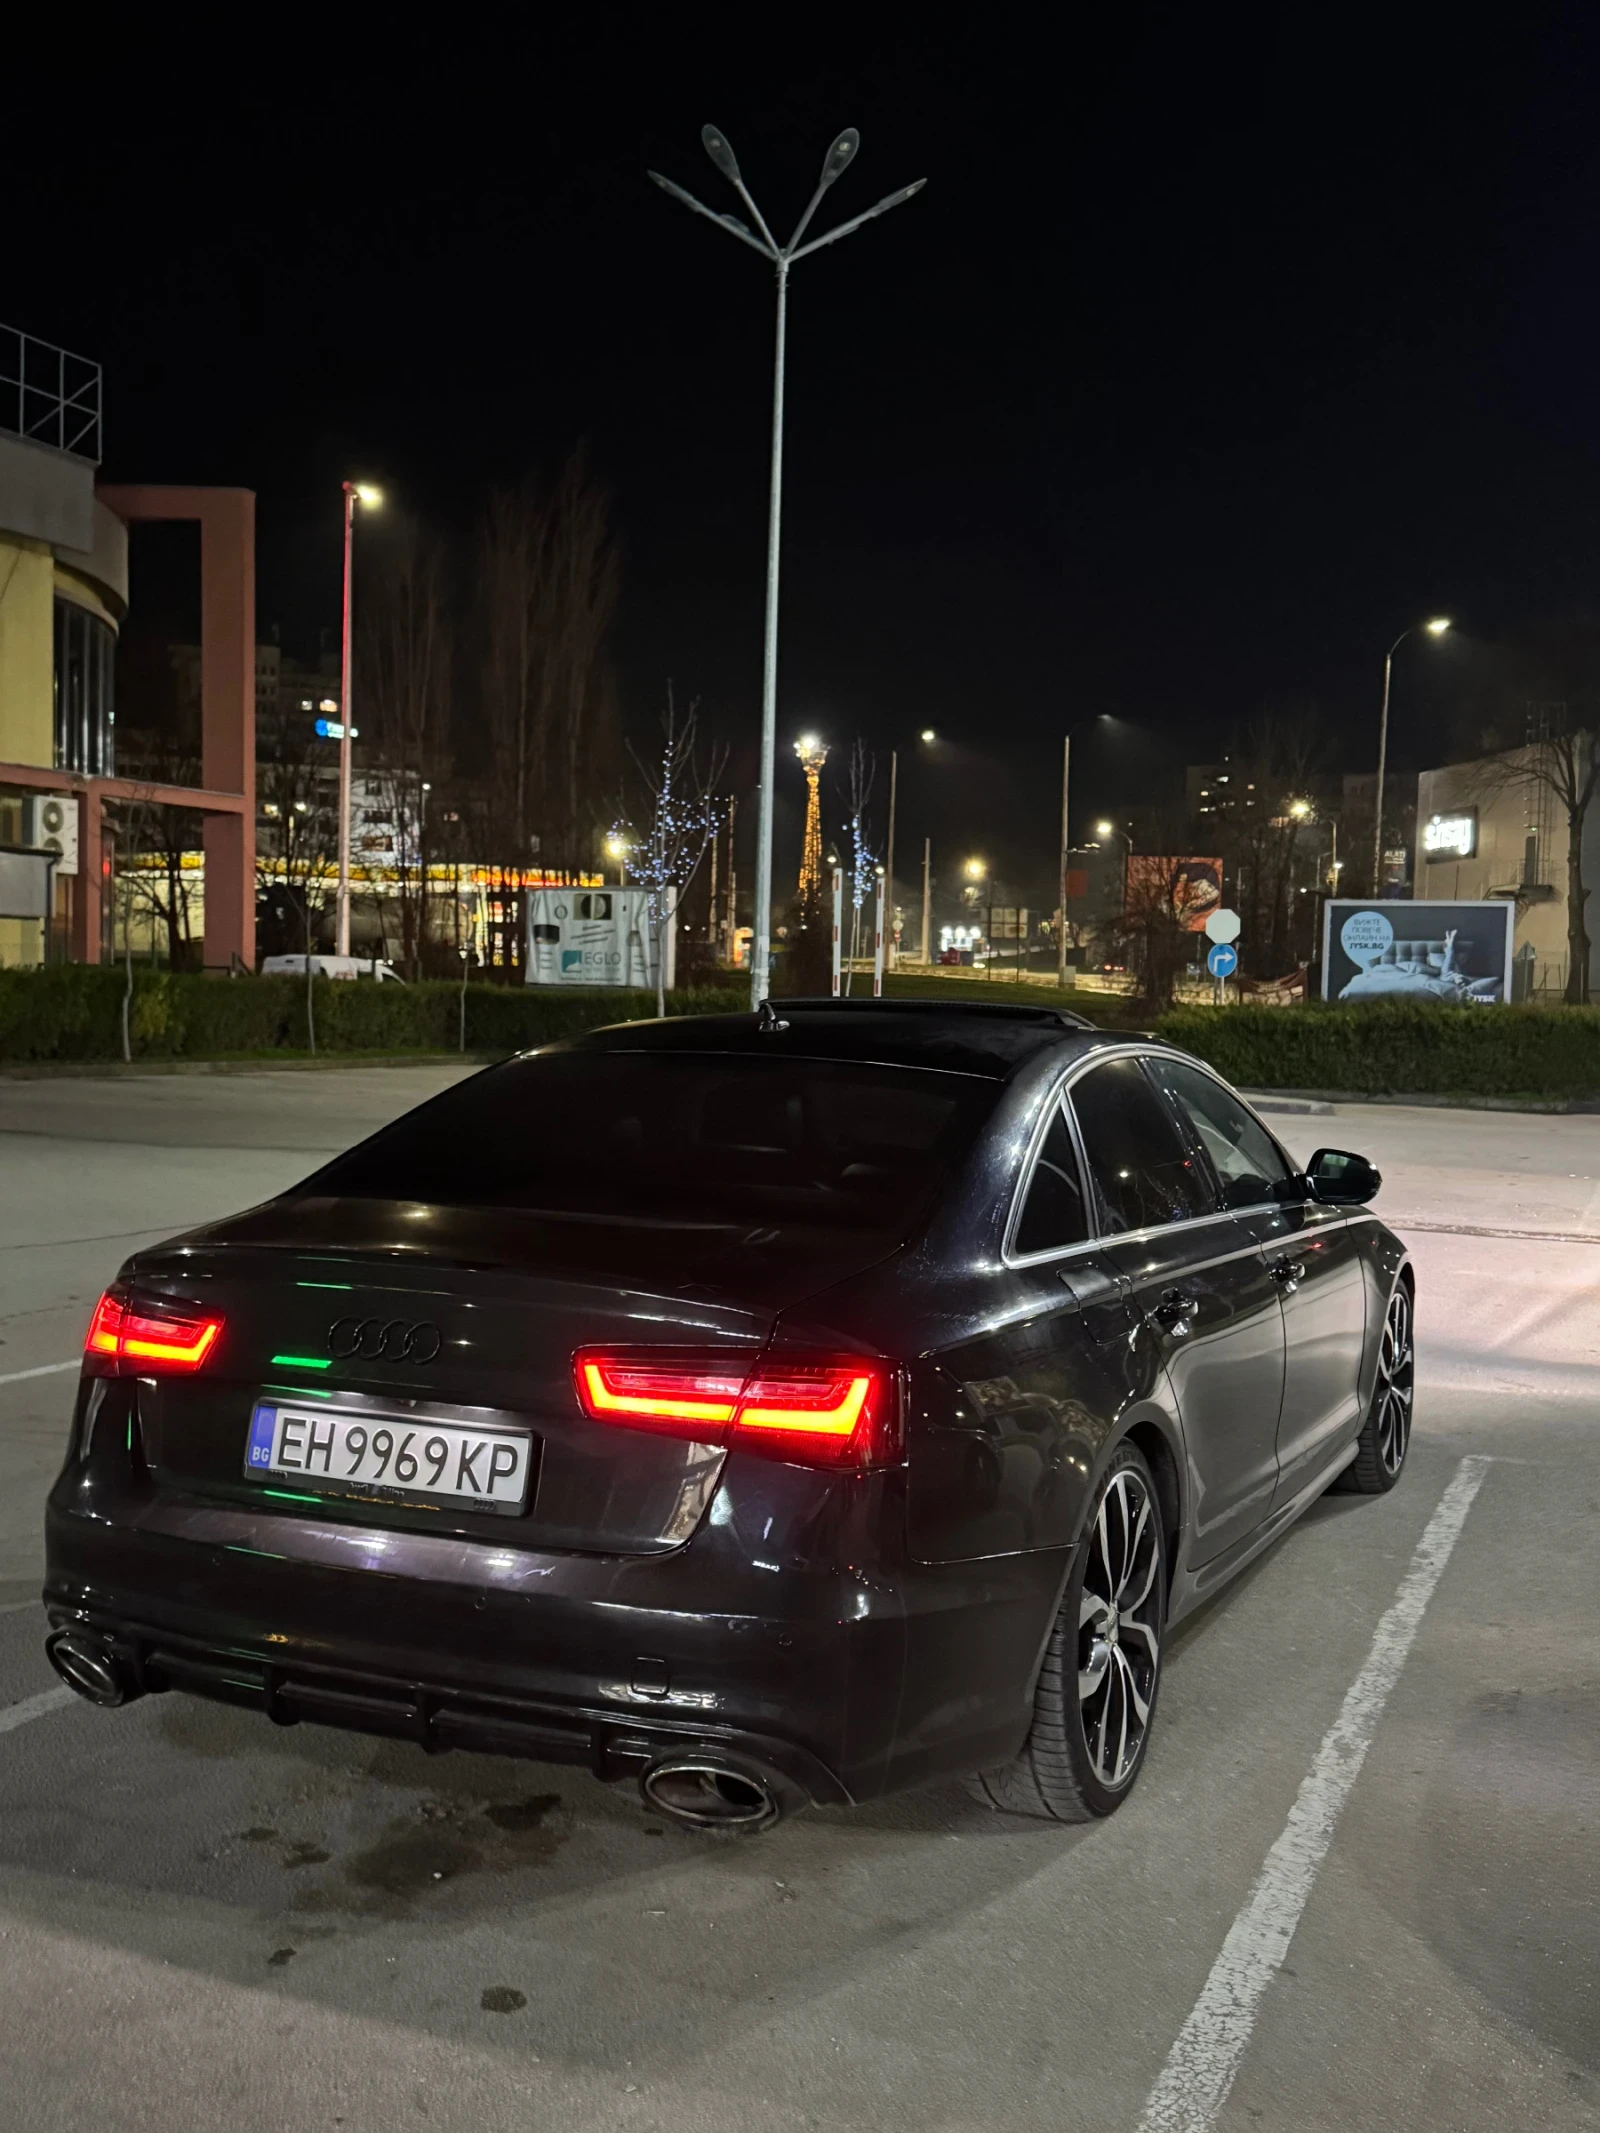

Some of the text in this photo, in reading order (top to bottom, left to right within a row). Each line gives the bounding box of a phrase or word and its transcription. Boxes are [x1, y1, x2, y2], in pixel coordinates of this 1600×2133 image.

[1349, 942, 1384, 950] JYSK.BG
[584, 951, 622, 965] EGLO
[251, 1445, 270, 1463] BG
